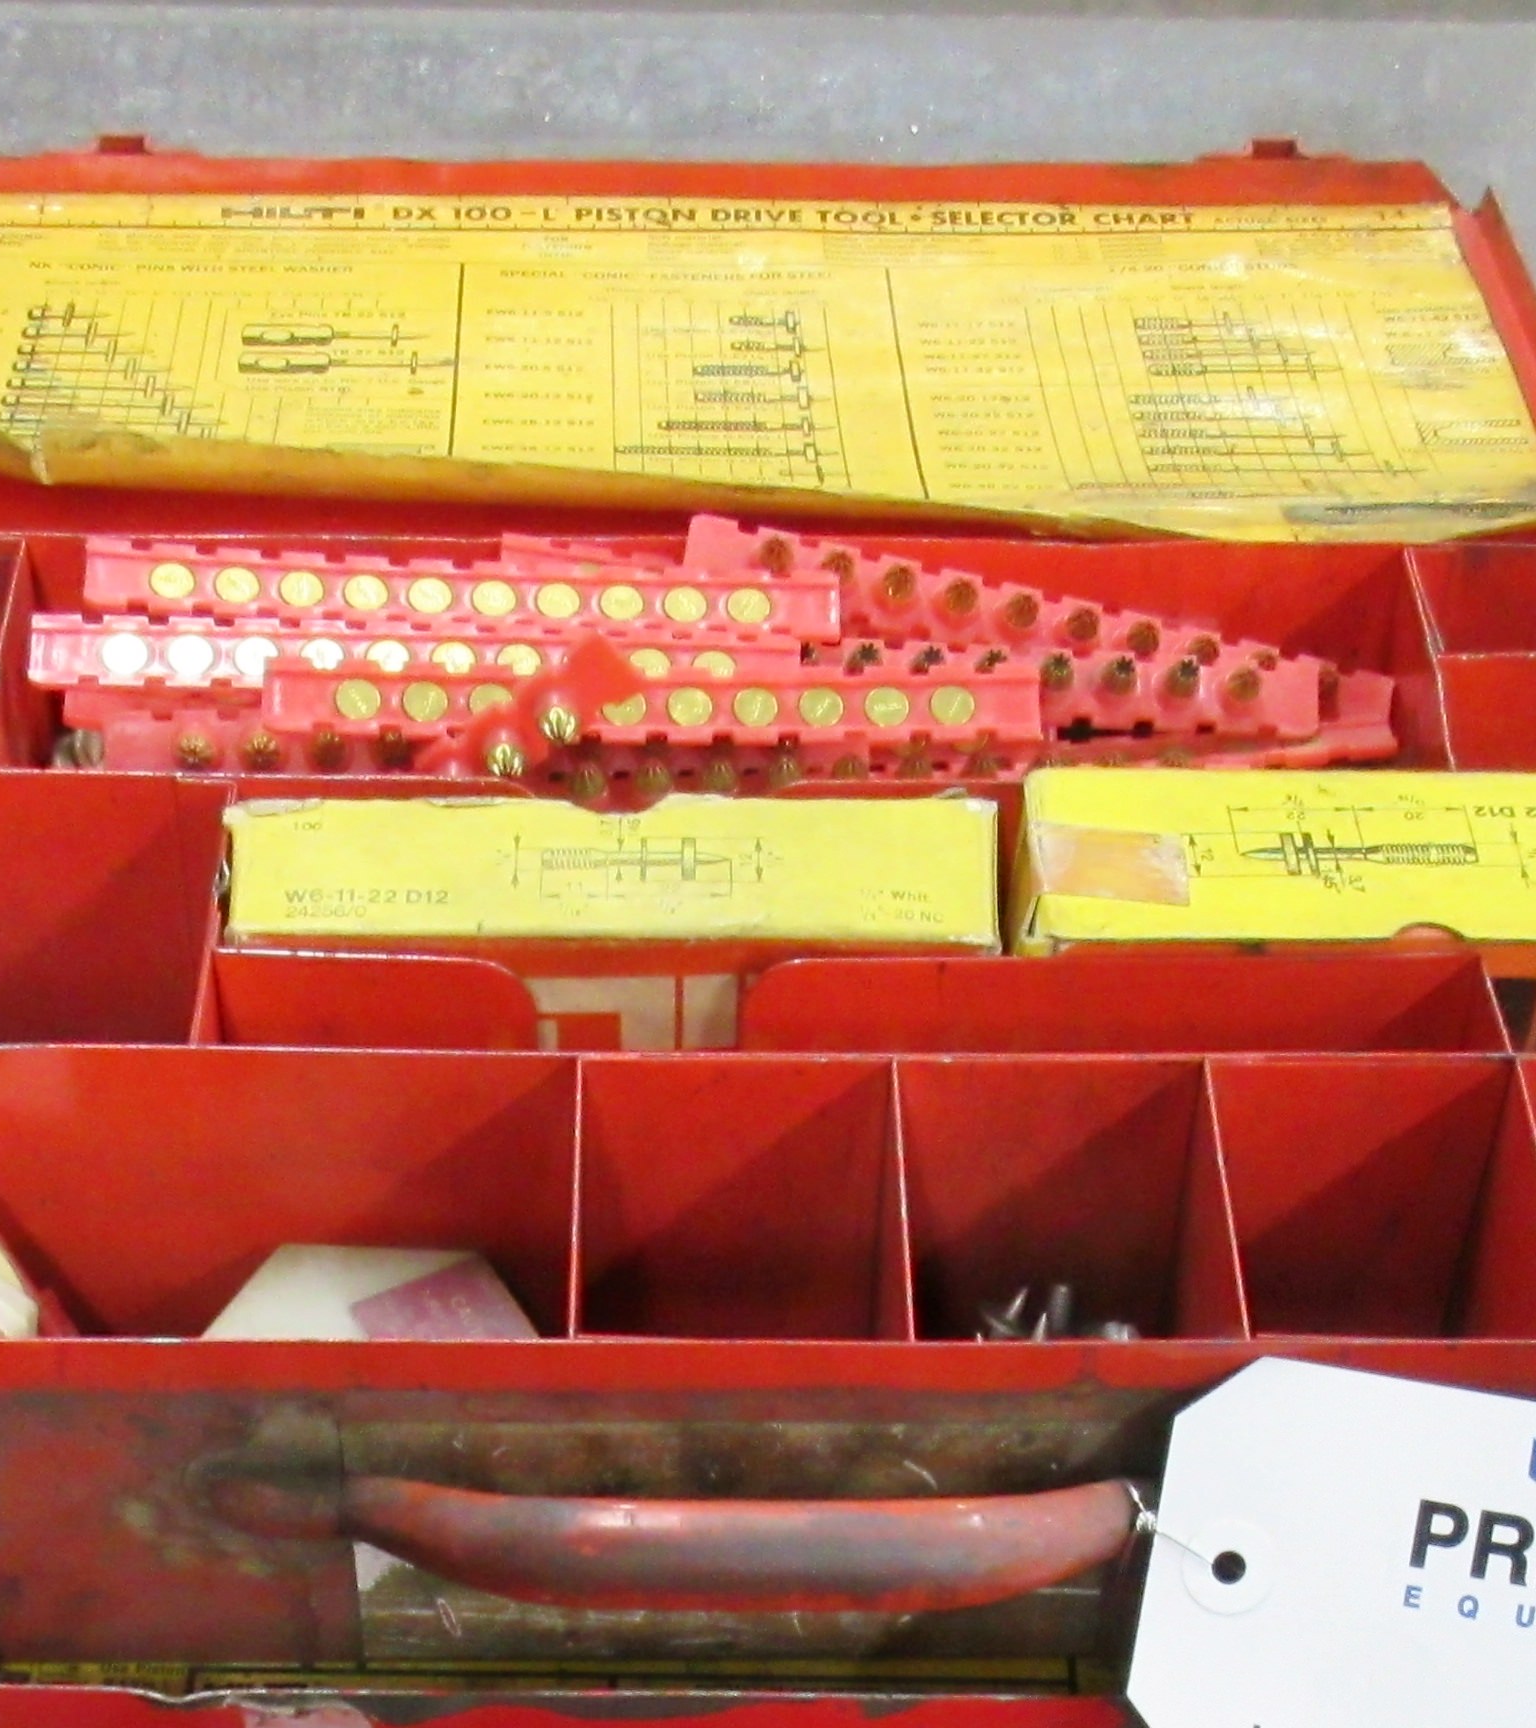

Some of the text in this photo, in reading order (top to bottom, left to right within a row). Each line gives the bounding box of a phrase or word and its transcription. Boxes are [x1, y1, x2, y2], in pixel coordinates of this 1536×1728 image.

[221, 206, 364, 220] HILTI
[393, 207, 437, 220] DX
[575, 207, 697, 223] PISTON
[711, 208, 802, 223] DRIVE
[816, 209, 904, 226] TOOL
[931, 210, 1077, 226] SELECTOR
[1093, 212, 1194, 226] CHART
[1473, 805, 1515, 818] D12
[284, 888, 449, 905] W6-11-22 D12
